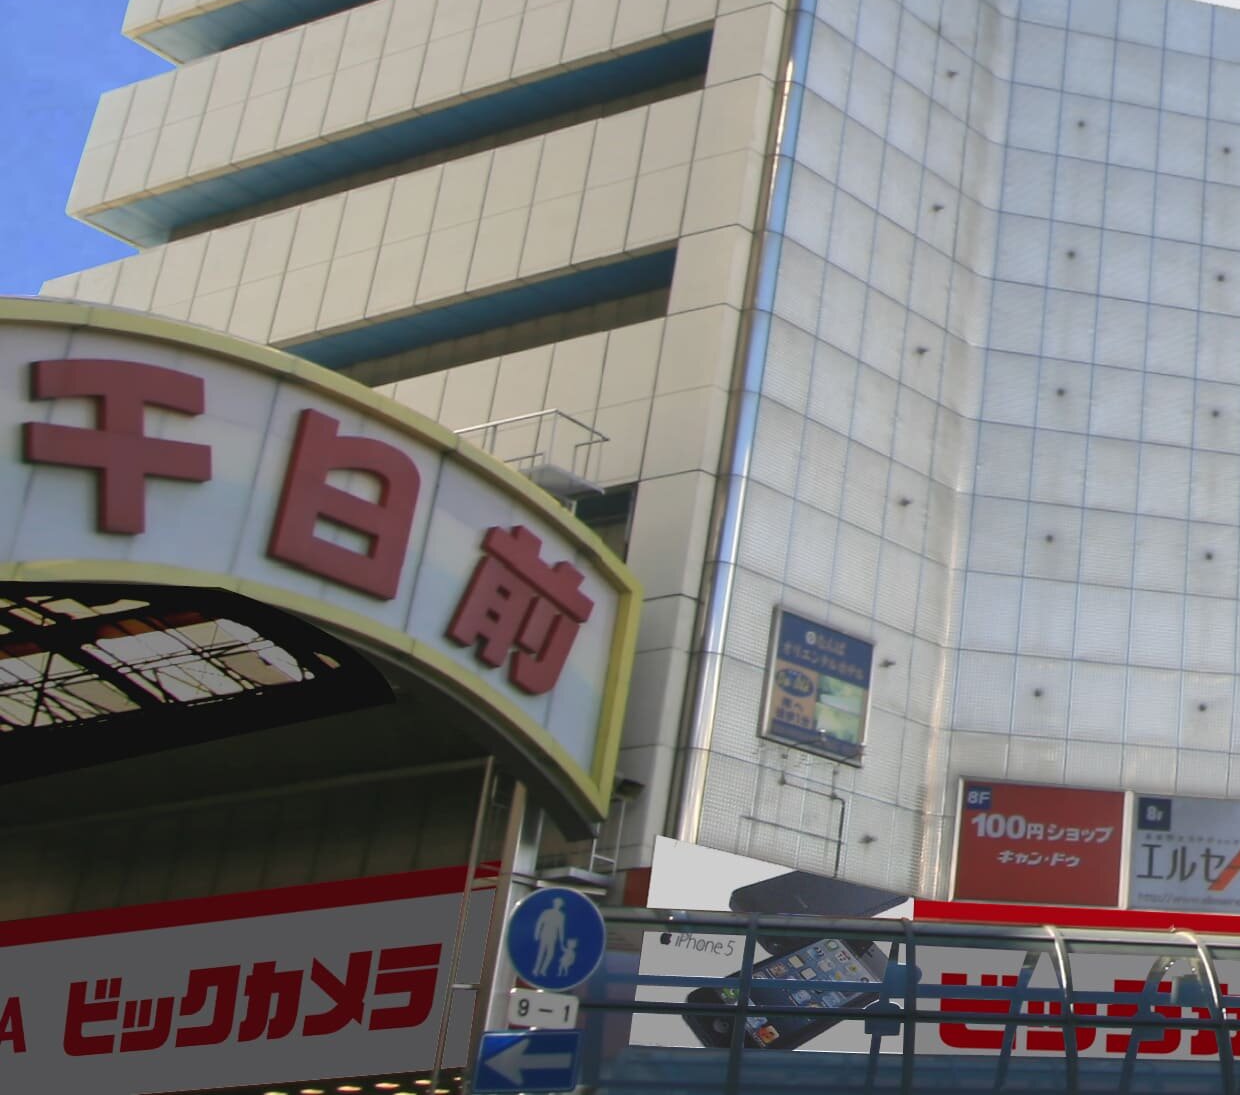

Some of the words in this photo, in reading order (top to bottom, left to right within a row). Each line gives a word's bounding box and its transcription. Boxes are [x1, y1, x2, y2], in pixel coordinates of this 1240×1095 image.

[23, 358, 595, 695] 千日前
[967, 790, 992, 805] 8F
[971, 813, 1115, 843] 100円ショップ
[675, 932, 723, 954] iPhone
[723, 940, 734, 956] 5
[63, 943, 442, 1057] ビックカメラ
